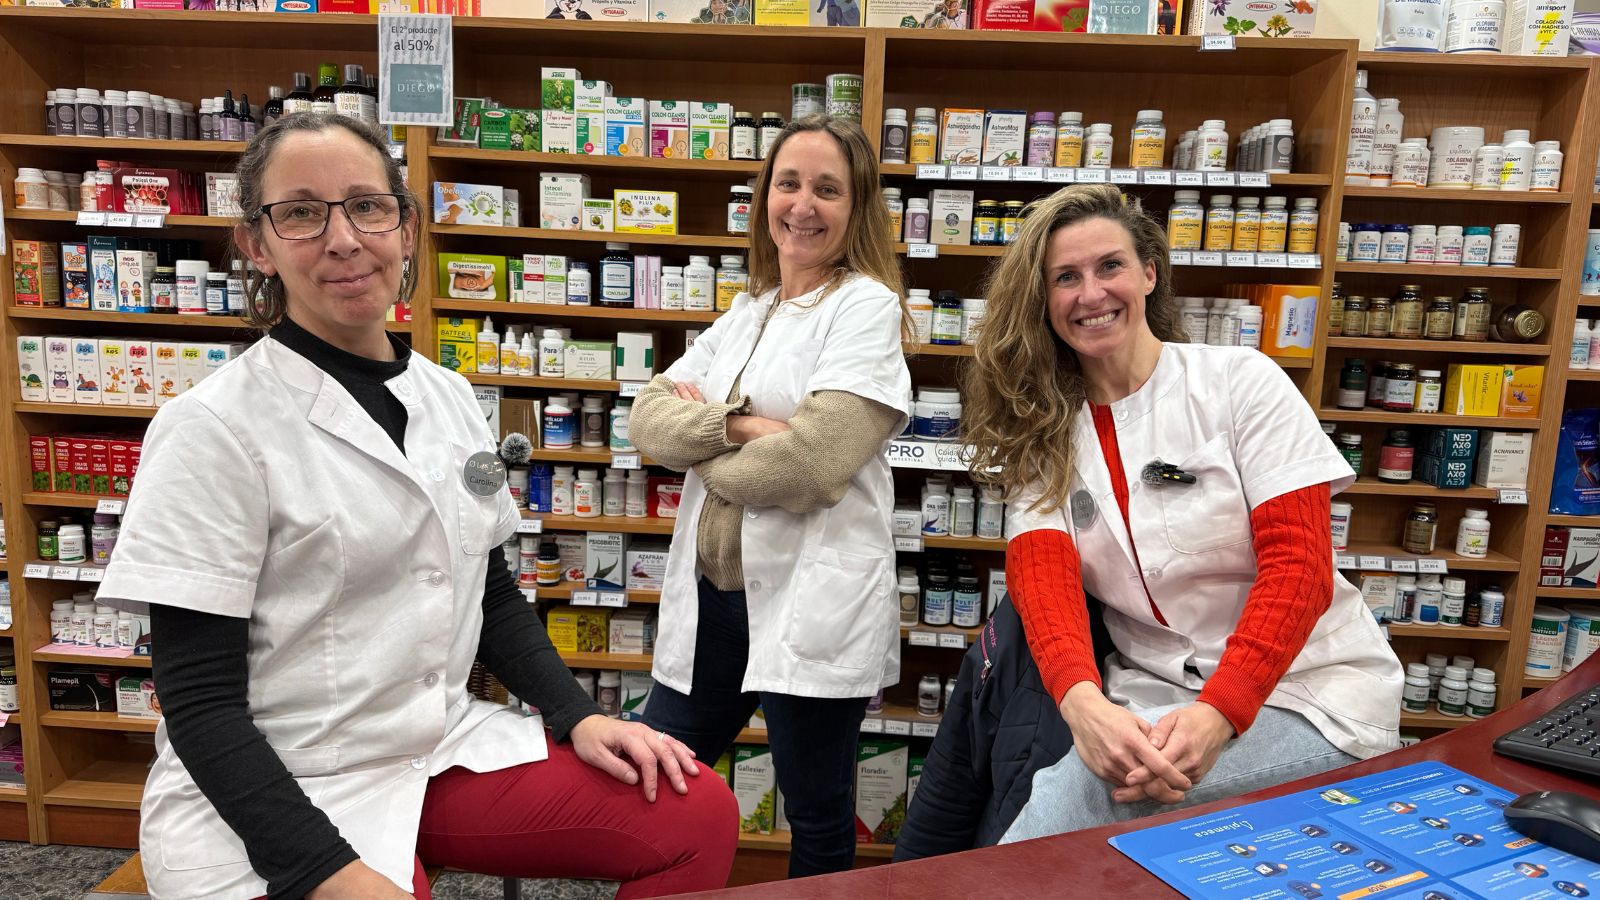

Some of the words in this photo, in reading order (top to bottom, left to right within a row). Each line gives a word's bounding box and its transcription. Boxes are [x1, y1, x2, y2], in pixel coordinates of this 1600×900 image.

[392, 26, 398, 34] El
[394, 39, 404, 51] al
[408, 40, 435, 52] 50%
[340, 102, 359, 110] Water
[947, 123, 981, 131] Ashwagandha
[1286, 308, 1294, 336] Magnesio
[470, 476, 498, 488] Carolina
[51, 677, 79, 685] Plamepil
[1194, 820, 1240, 839] plameca
